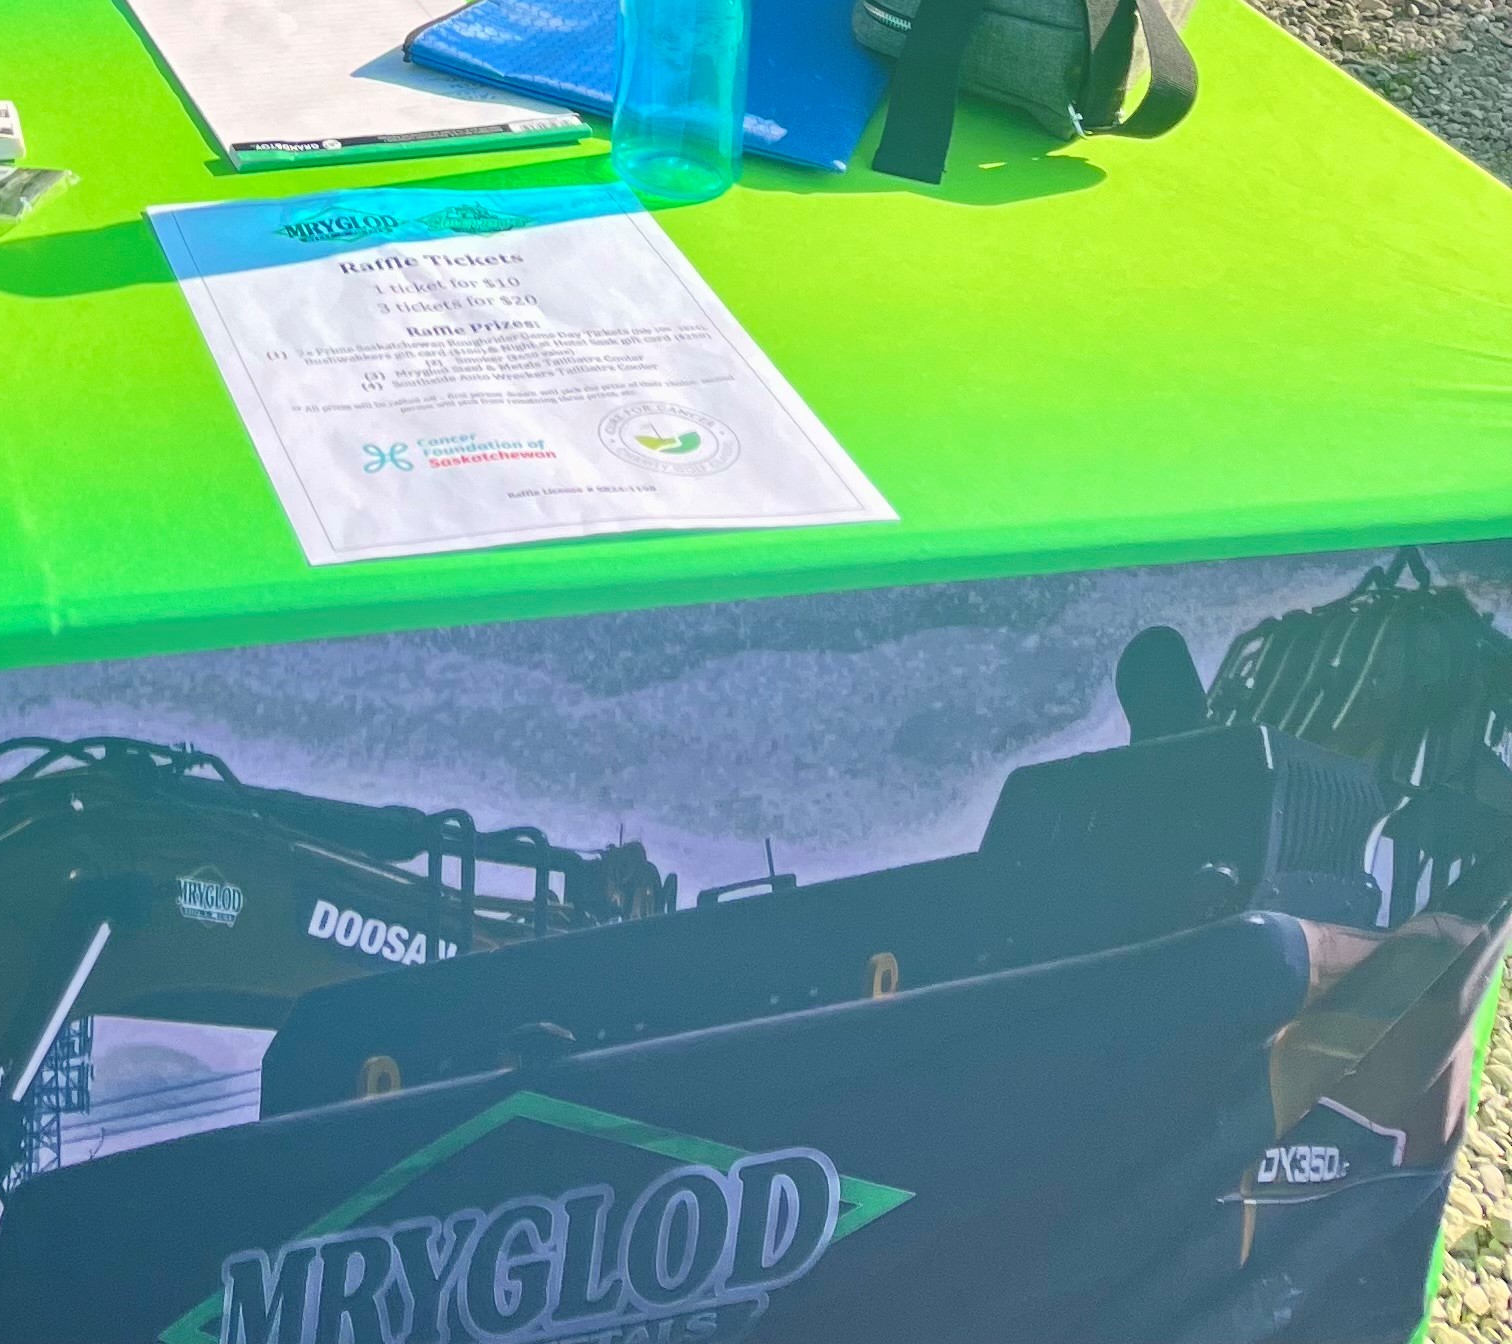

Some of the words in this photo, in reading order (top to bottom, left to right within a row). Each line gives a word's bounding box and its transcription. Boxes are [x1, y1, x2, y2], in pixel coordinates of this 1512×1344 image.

[338, 255, 420, 275] Raffle
[423, 252, 525, 269] Tickets
[389, 279, 443, 296] ticket
[449, 277, 478, 289] for
[394, 299, 463, 314] tickets
[467, 295, 495, 308] for
[498, 294, 538, 307] $20
[405, 324, 466, 338] Raffle
[417, 432, 477, 448] Cancer
[422, 440, 523, 458] Foundation
[526, 439, 546, 450] of
[428, 449, 558, 469] Saskatchewan
[222, 1147, 840, 1344] MRYGLOD
